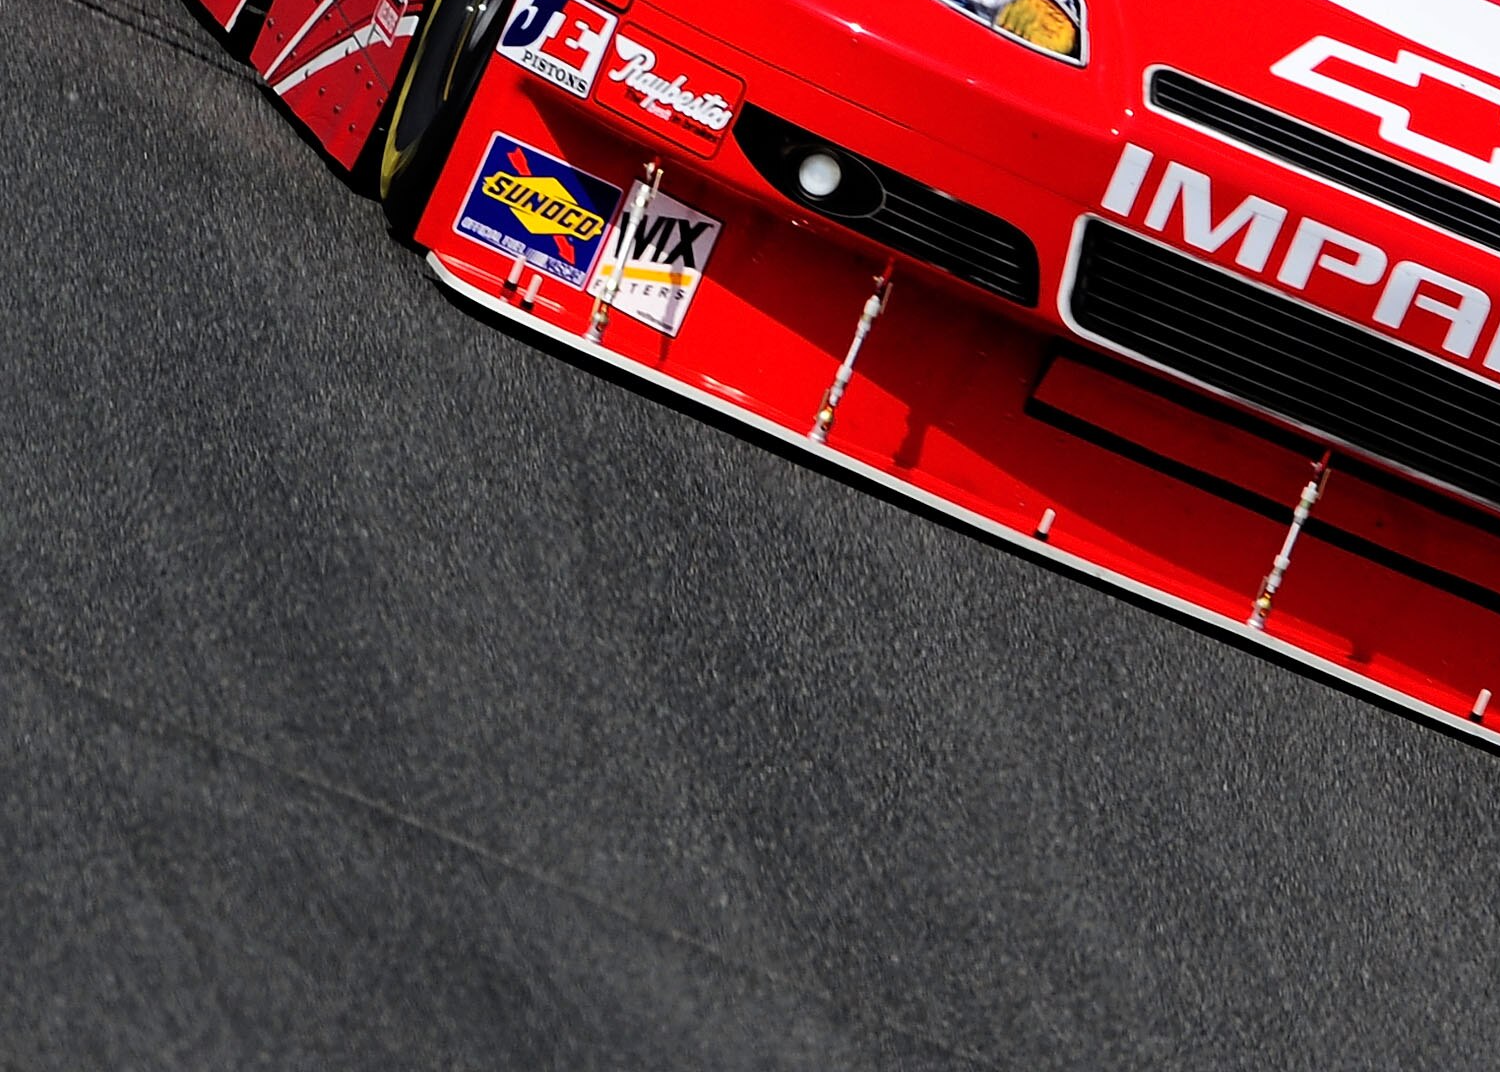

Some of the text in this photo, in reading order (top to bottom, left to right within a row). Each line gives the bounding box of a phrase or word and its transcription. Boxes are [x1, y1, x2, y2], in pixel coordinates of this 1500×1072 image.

[521, 49, 589, 96] PISTONS
[607, 33, 734, 131] Raybestos
[488, 175, 600, 237] SUNOCO
[615, 211, 715, 269] WIX
